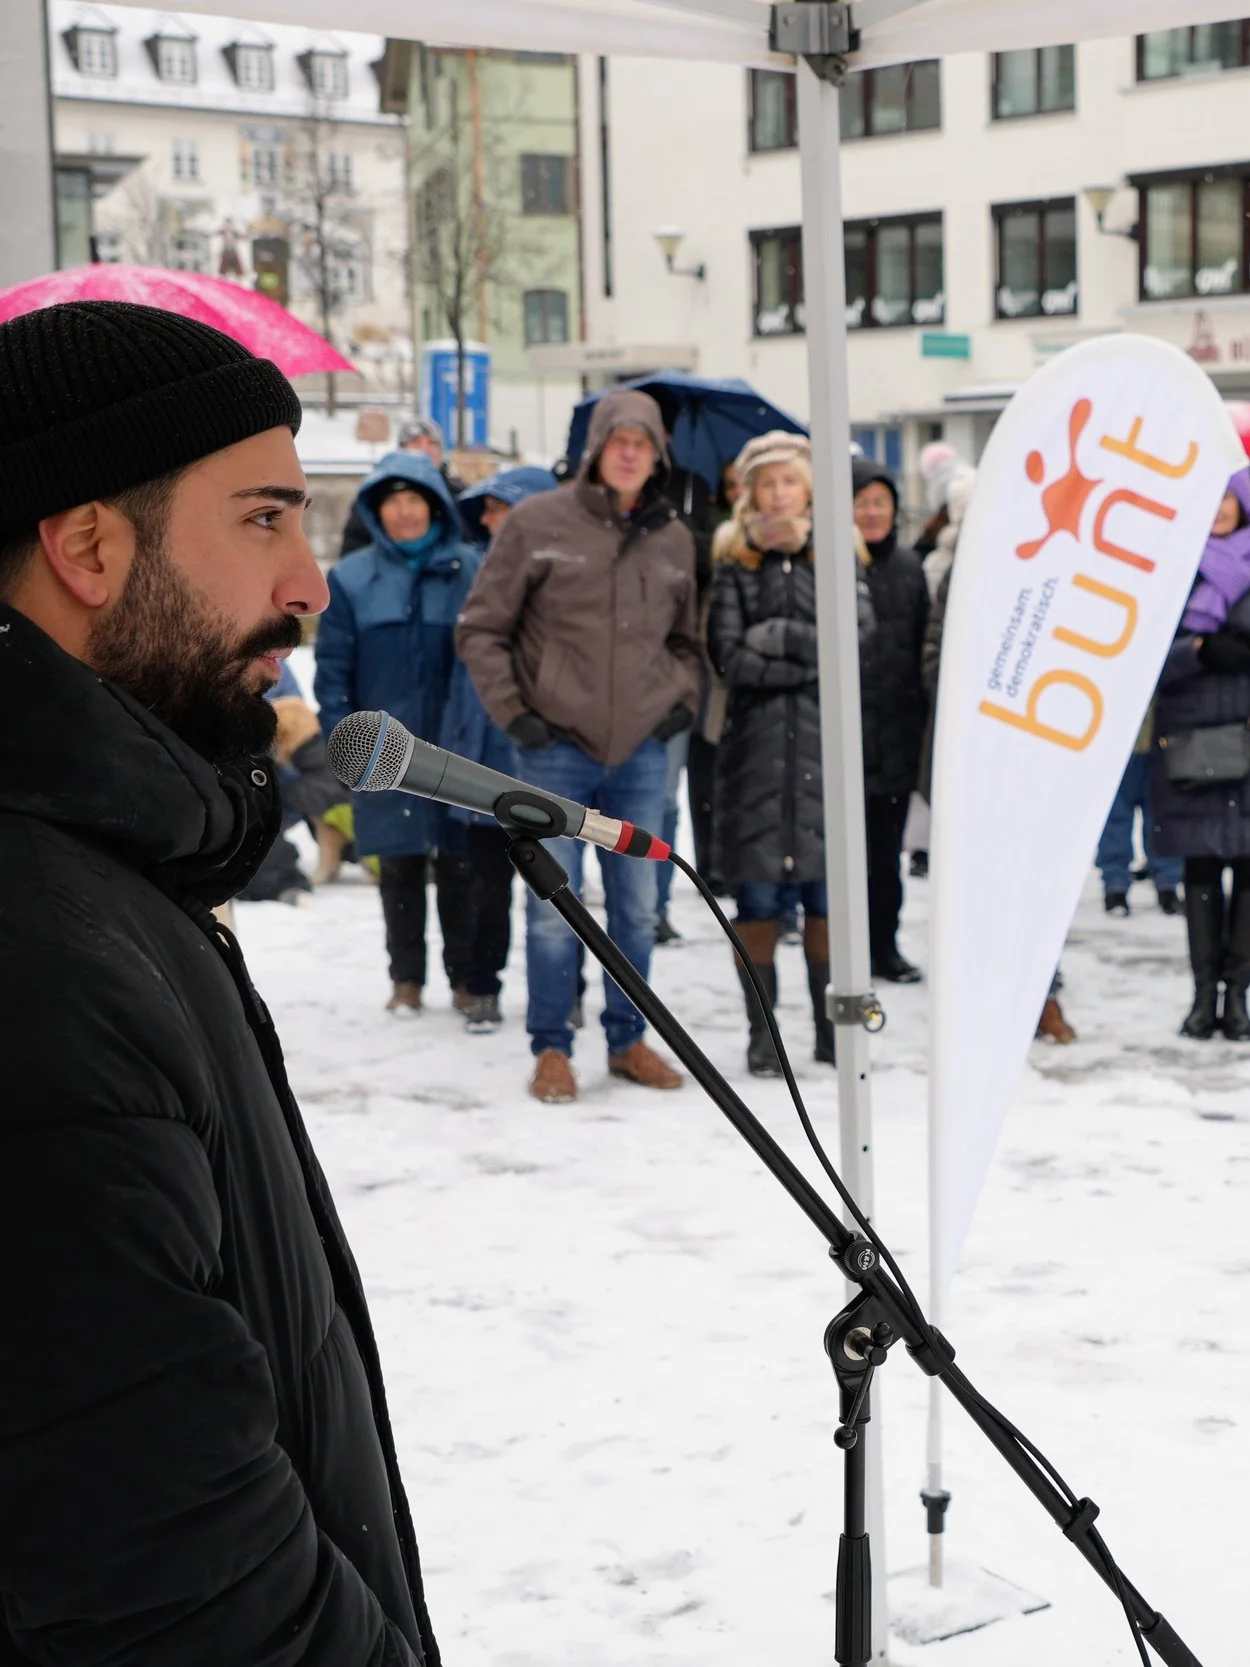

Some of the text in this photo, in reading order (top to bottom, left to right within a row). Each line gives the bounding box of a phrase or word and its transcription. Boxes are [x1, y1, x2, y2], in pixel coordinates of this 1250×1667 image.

[978, 415, 1199, 753] bunt
[987, 586, 1034, 692] gemeinsam.
[1006, 576, 1060, 698] demokratisch.
